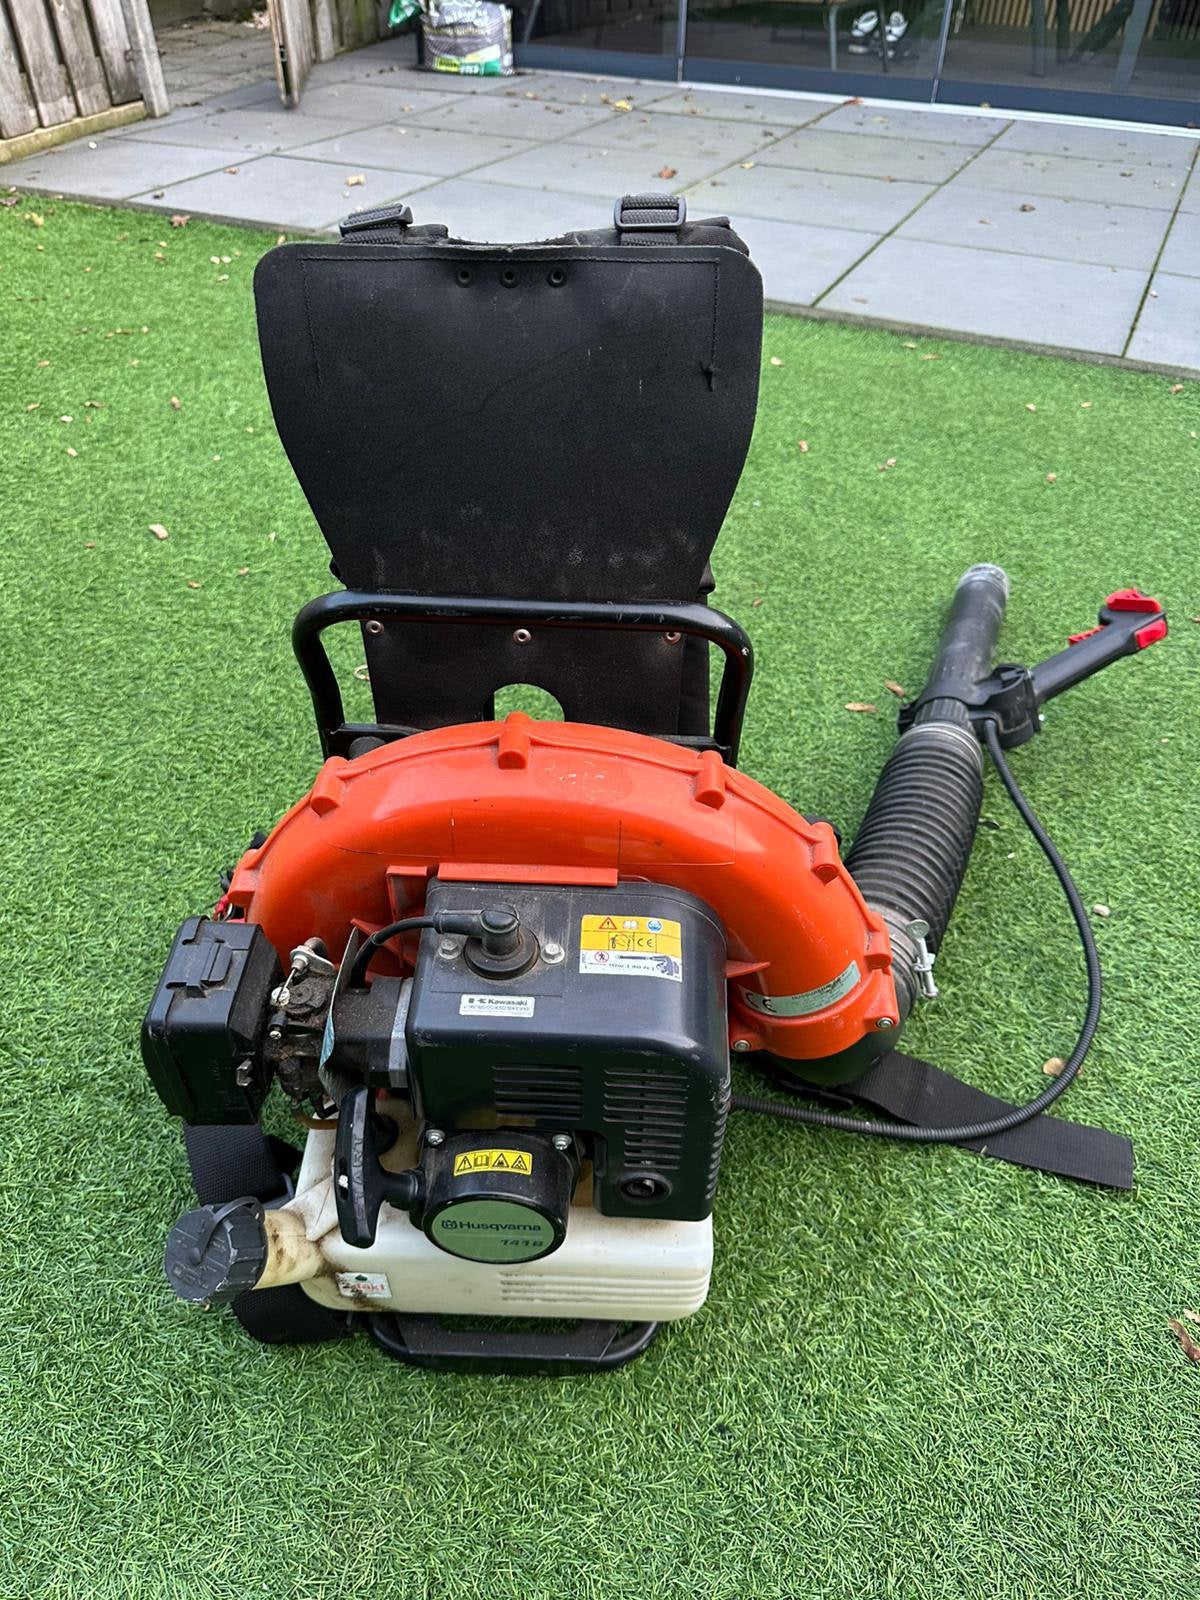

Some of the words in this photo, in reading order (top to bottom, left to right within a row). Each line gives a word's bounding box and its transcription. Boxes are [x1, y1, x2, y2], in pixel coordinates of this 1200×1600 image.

[488, 998, 528, 1006] Kawasaki
[352, 1134, 366, 1220] START
[459, 1221, 542, 1232] Husqvarna
